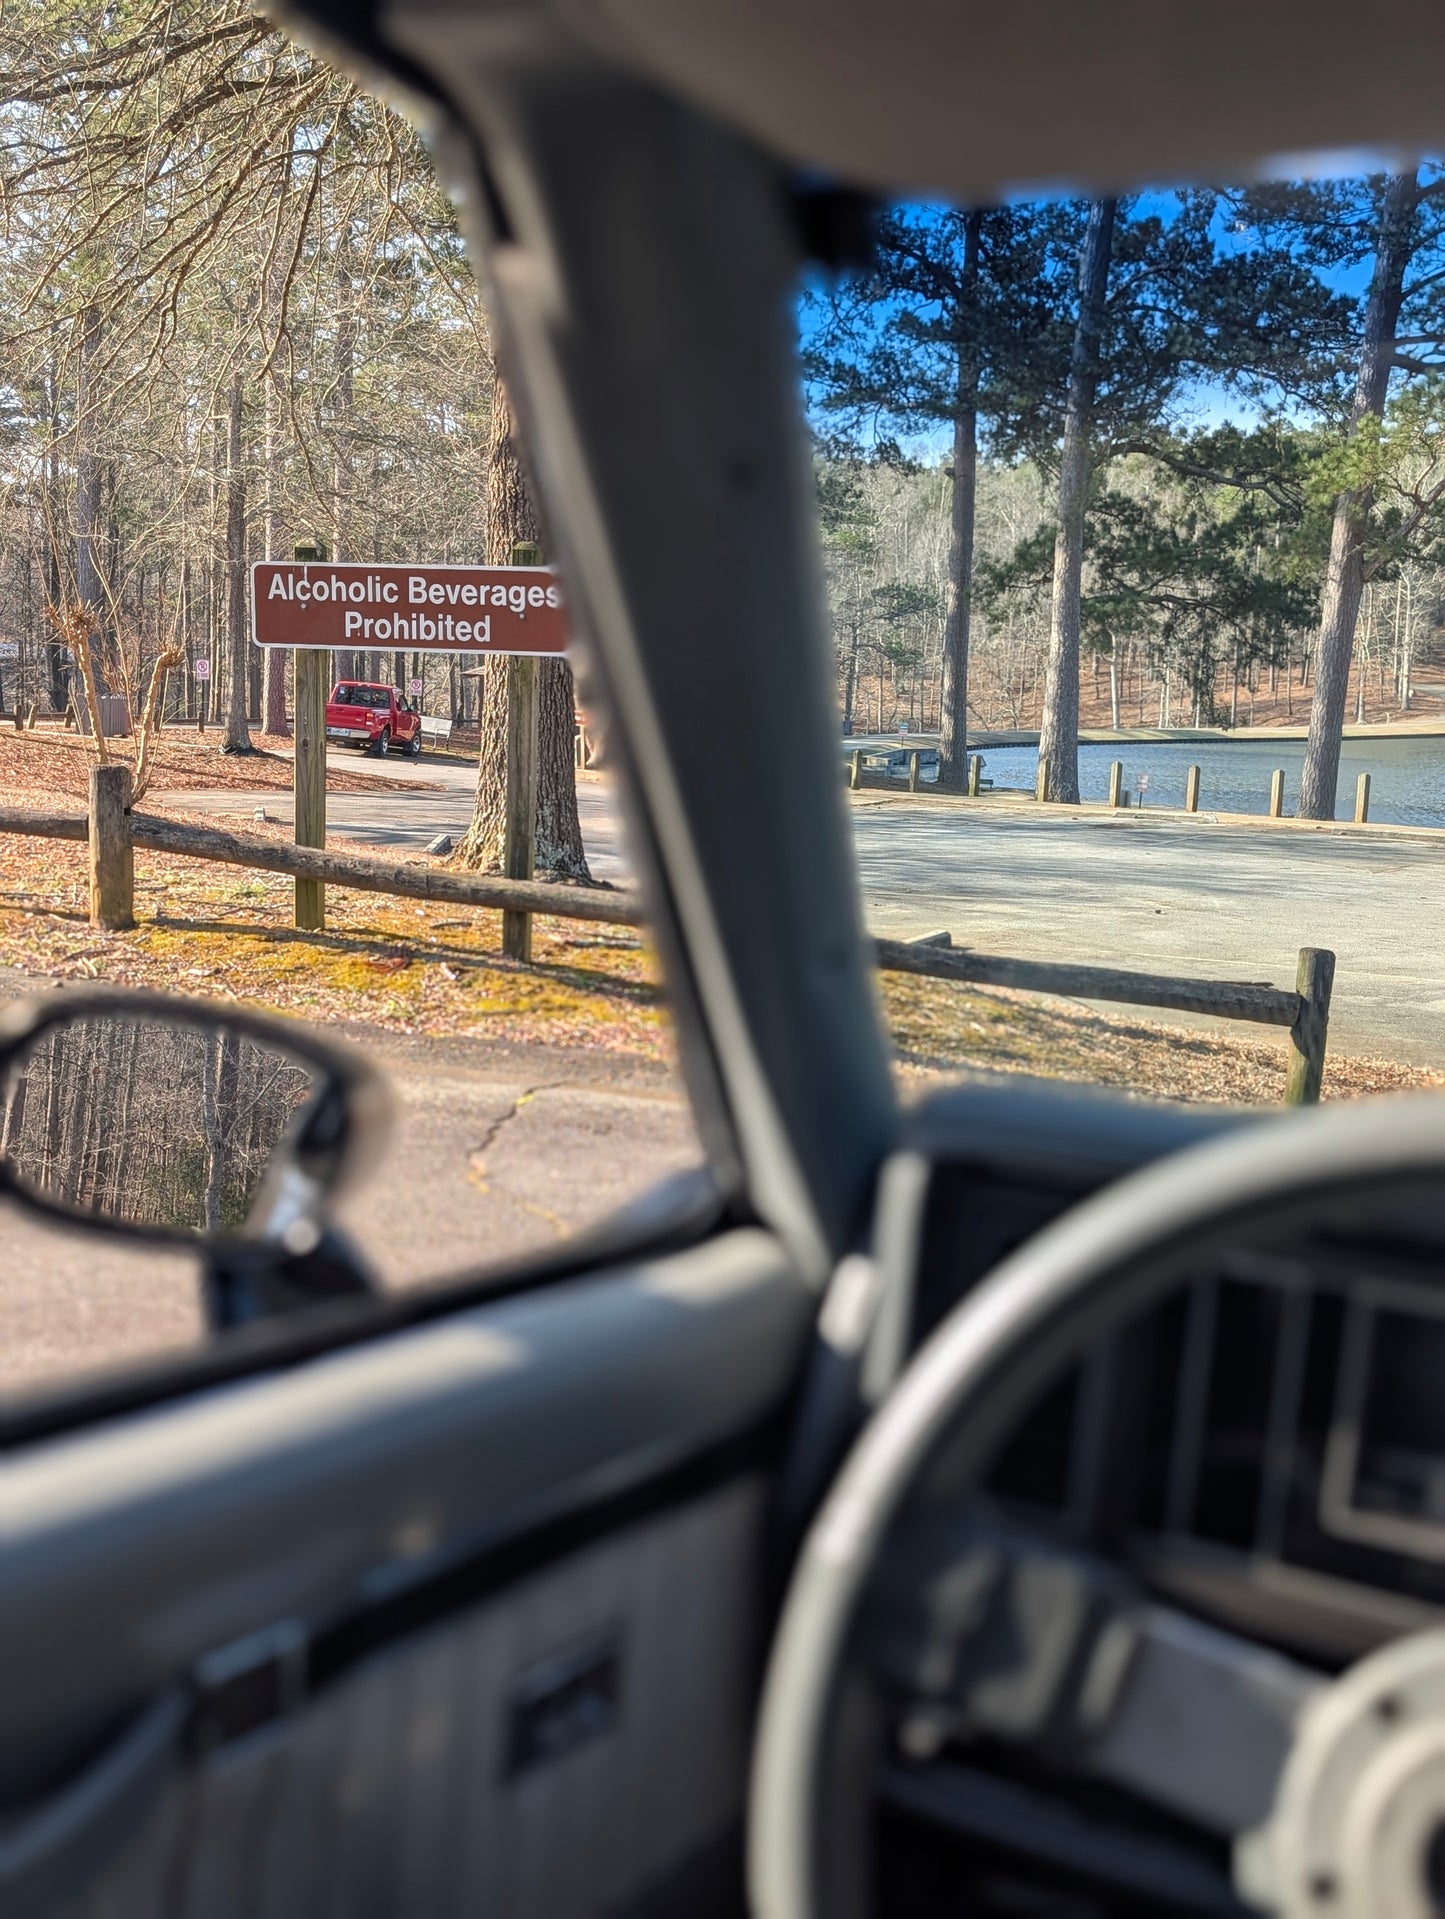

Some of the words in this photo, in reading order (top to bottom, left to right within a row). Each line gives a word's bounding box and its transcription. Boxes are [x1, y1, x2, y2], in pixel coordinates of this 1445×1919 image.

[268, 573, 399, 603] Alcoholic
[408, 576, 561, 612] Beverages
[344, 611, 491, 642] Prohibited
